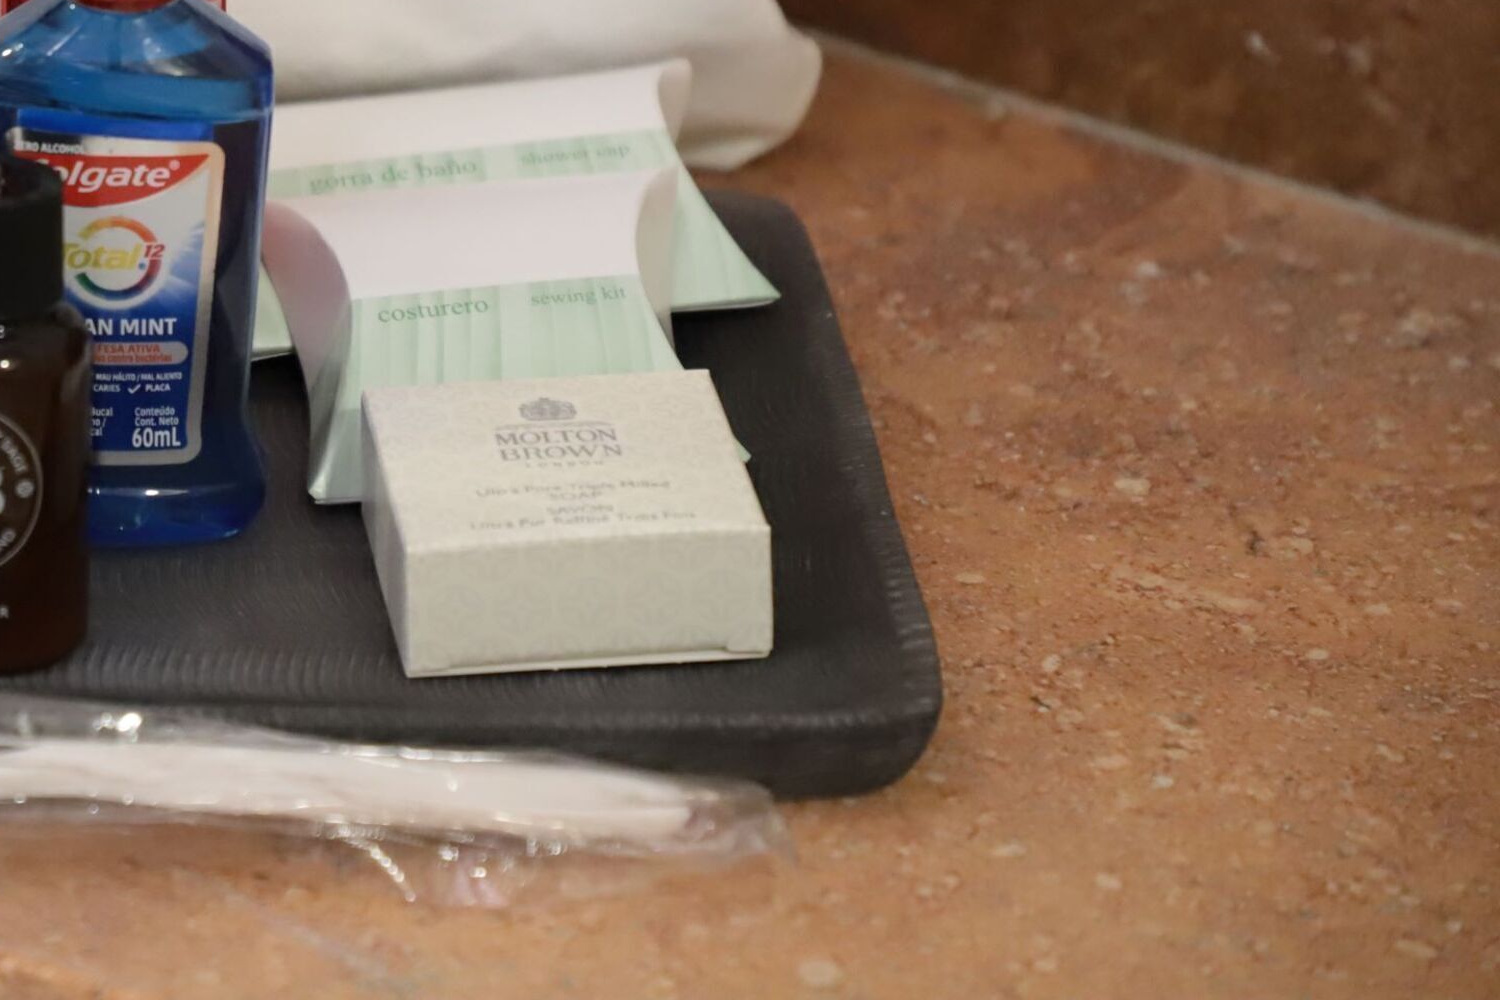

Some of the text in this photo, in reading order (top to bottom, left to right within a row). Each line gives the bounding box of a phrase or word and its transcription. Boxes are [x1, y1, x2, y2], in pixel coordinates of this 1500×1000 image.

[41, 142, 86, 154] ALCOHOL
[36, 158, 171, 194] olgate
[308, 143, 631, 196] gorra de baño shower cap
[377, 284, 627, 324] costurero sewing kit
[120, 318, 178, 336] MINT
[145, 383, 171, 393] PLACA
[134, 405, 175, 417] Conteúdo
[134, 416, 180, 427] Cont. Neto
[131, 427, 182, 448] 60mL
[495, 427, 618, 447] MOLTON
[499, 444, 623, 462] BROWN
